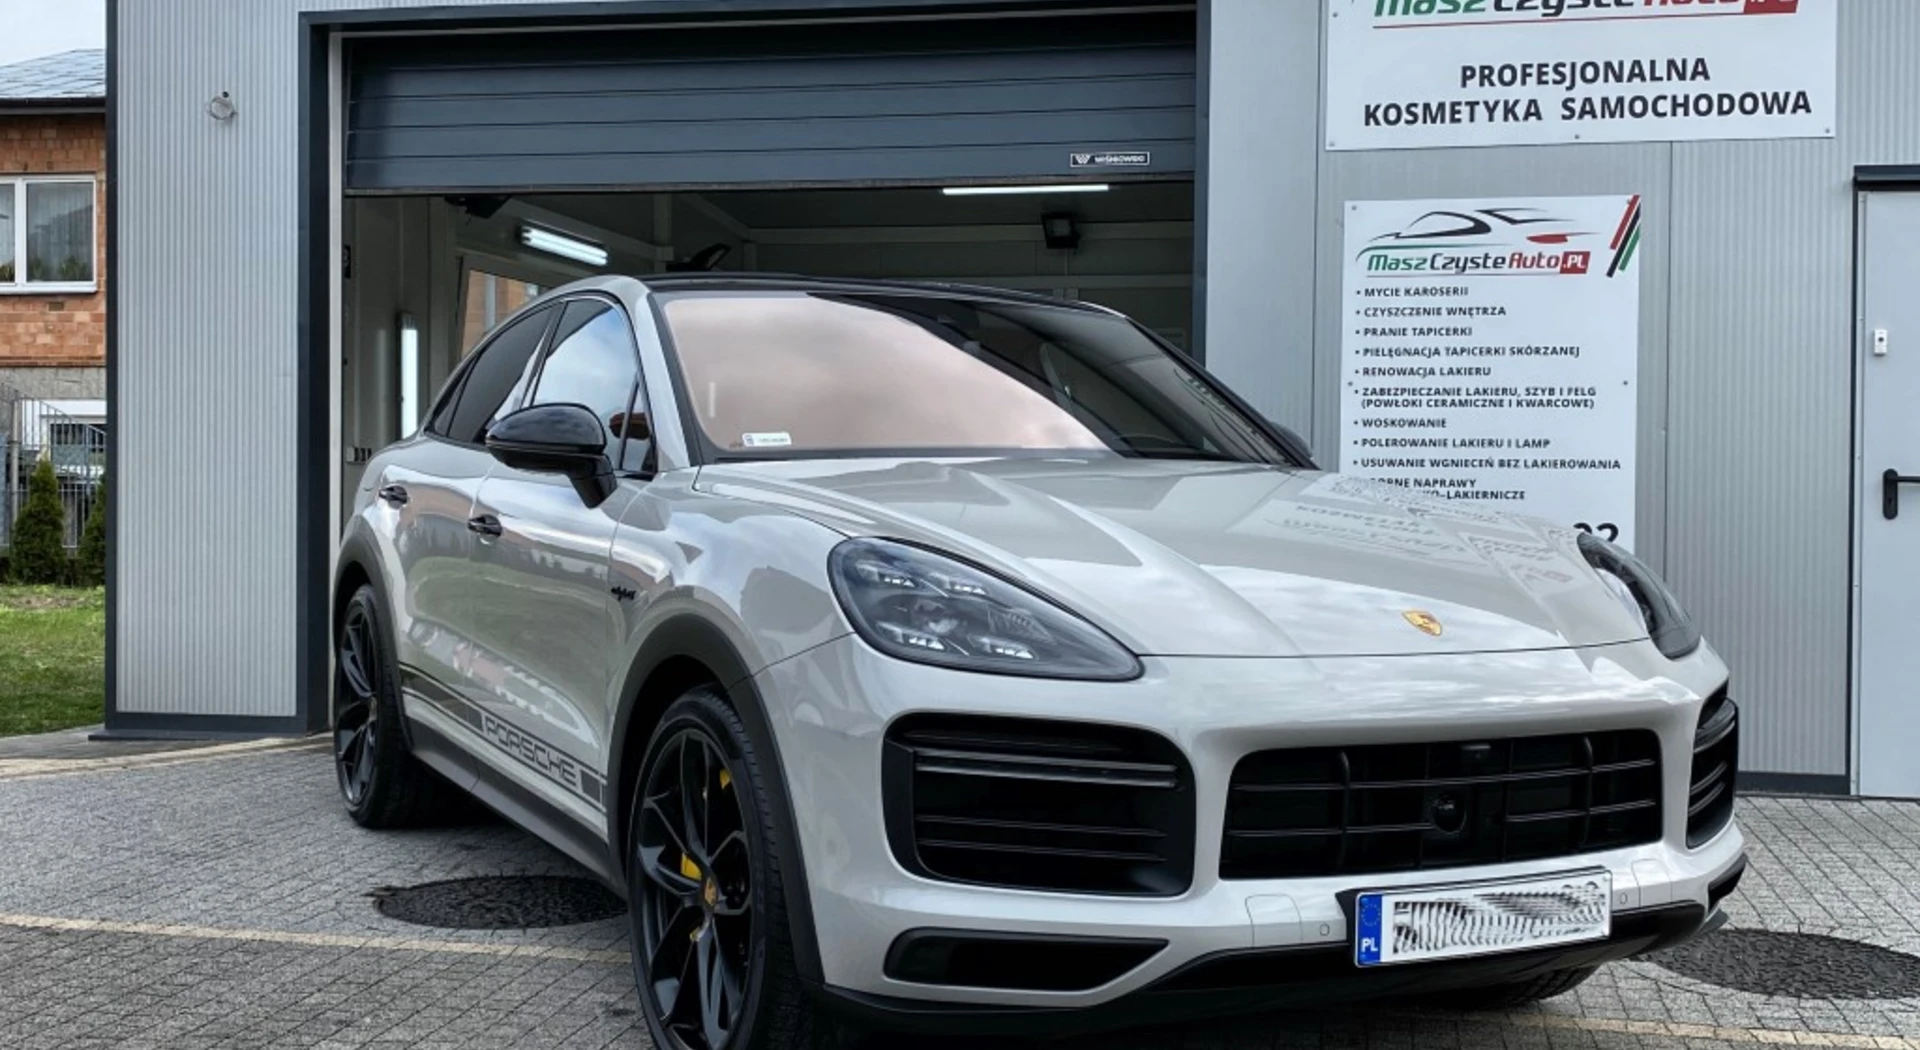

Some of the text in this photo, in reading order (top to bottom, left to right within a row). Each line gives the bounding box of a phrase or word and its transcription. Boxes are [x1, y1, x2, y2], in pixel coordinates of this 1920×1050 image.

[1461, 58, 1710, 91] PROFESJONALNA
[1365, 91, 1811, 126] KOSMETYKA SAMOCHODOWA
[1364, 286, 1469, 298] MYCIE KAROSERII
[1363, 306, 1507, 319] CZYSZCZENIE WNĘTRZA
[1363, 326, 1473, 337] PRANIE TAPICERKI
[1362, 344, 1580, 359] PIELĘGNACJA TAPICERKI SKÓRZANEJ
[1362, 366, 1492, 379] RENOWACJA LAKIERU
[1362, 386, 1462, 397] ZABEZPIECZANIE
[1465, 386, 1521, 398] LAKIERU,
[1524, 386, 1556, 397] SZYB
[1566, 386, 1597, 397] FELG
[1360, 398, 1423, 410] (POWŁOKI
[1425, 398, 1505, 408] CERAMICZNE
[1515, 398, 1595, 410] KWARCOWE)
[1361, 417, 1447, 429] WOSKOWANIE
[1361, 437, 1448, 448] POLEROWANIE
[1452, 438, 1504, 449] LAKIERU
[1515, 438, 1551, 449] LAMP
[1360, 456, 1621, 470] USUWANIE WGNIECEŃ BEZ LAKIEROWANIA
[1413, 477, 1477, 489] NAPRAWY
[484, 714, 577, 788] PORSCHE
[1361, 937, 1379, 952] PL
